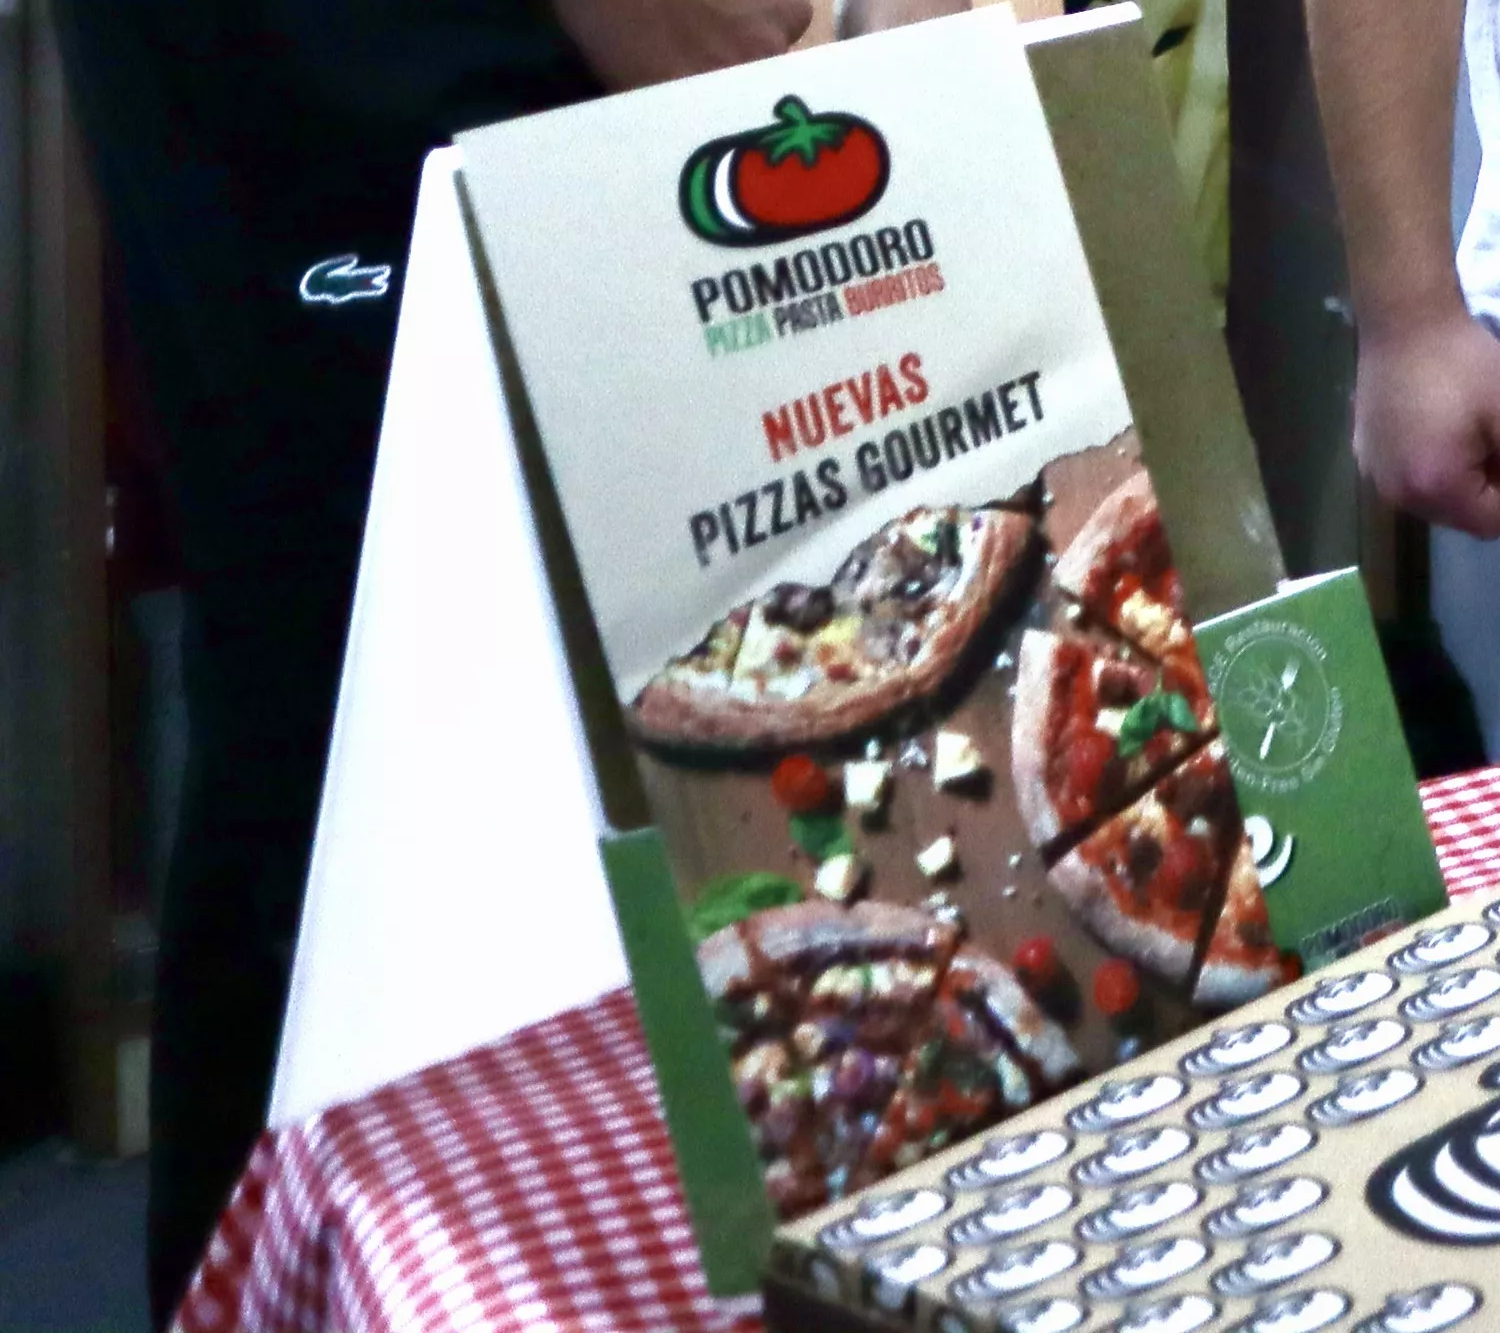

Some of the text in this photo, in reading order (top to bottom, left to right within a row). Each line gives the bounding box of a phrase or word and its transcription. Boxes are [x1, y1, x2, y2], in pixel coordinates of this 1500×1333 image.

[691, 218, 935, 323] POMODORO
[704, 261, 945, 358] PIZZA PASTA BURRITOS
[762, 351, 930, 463] NUEVAS
[688, 369, 1045, 568] PIZZAS GOURMET
